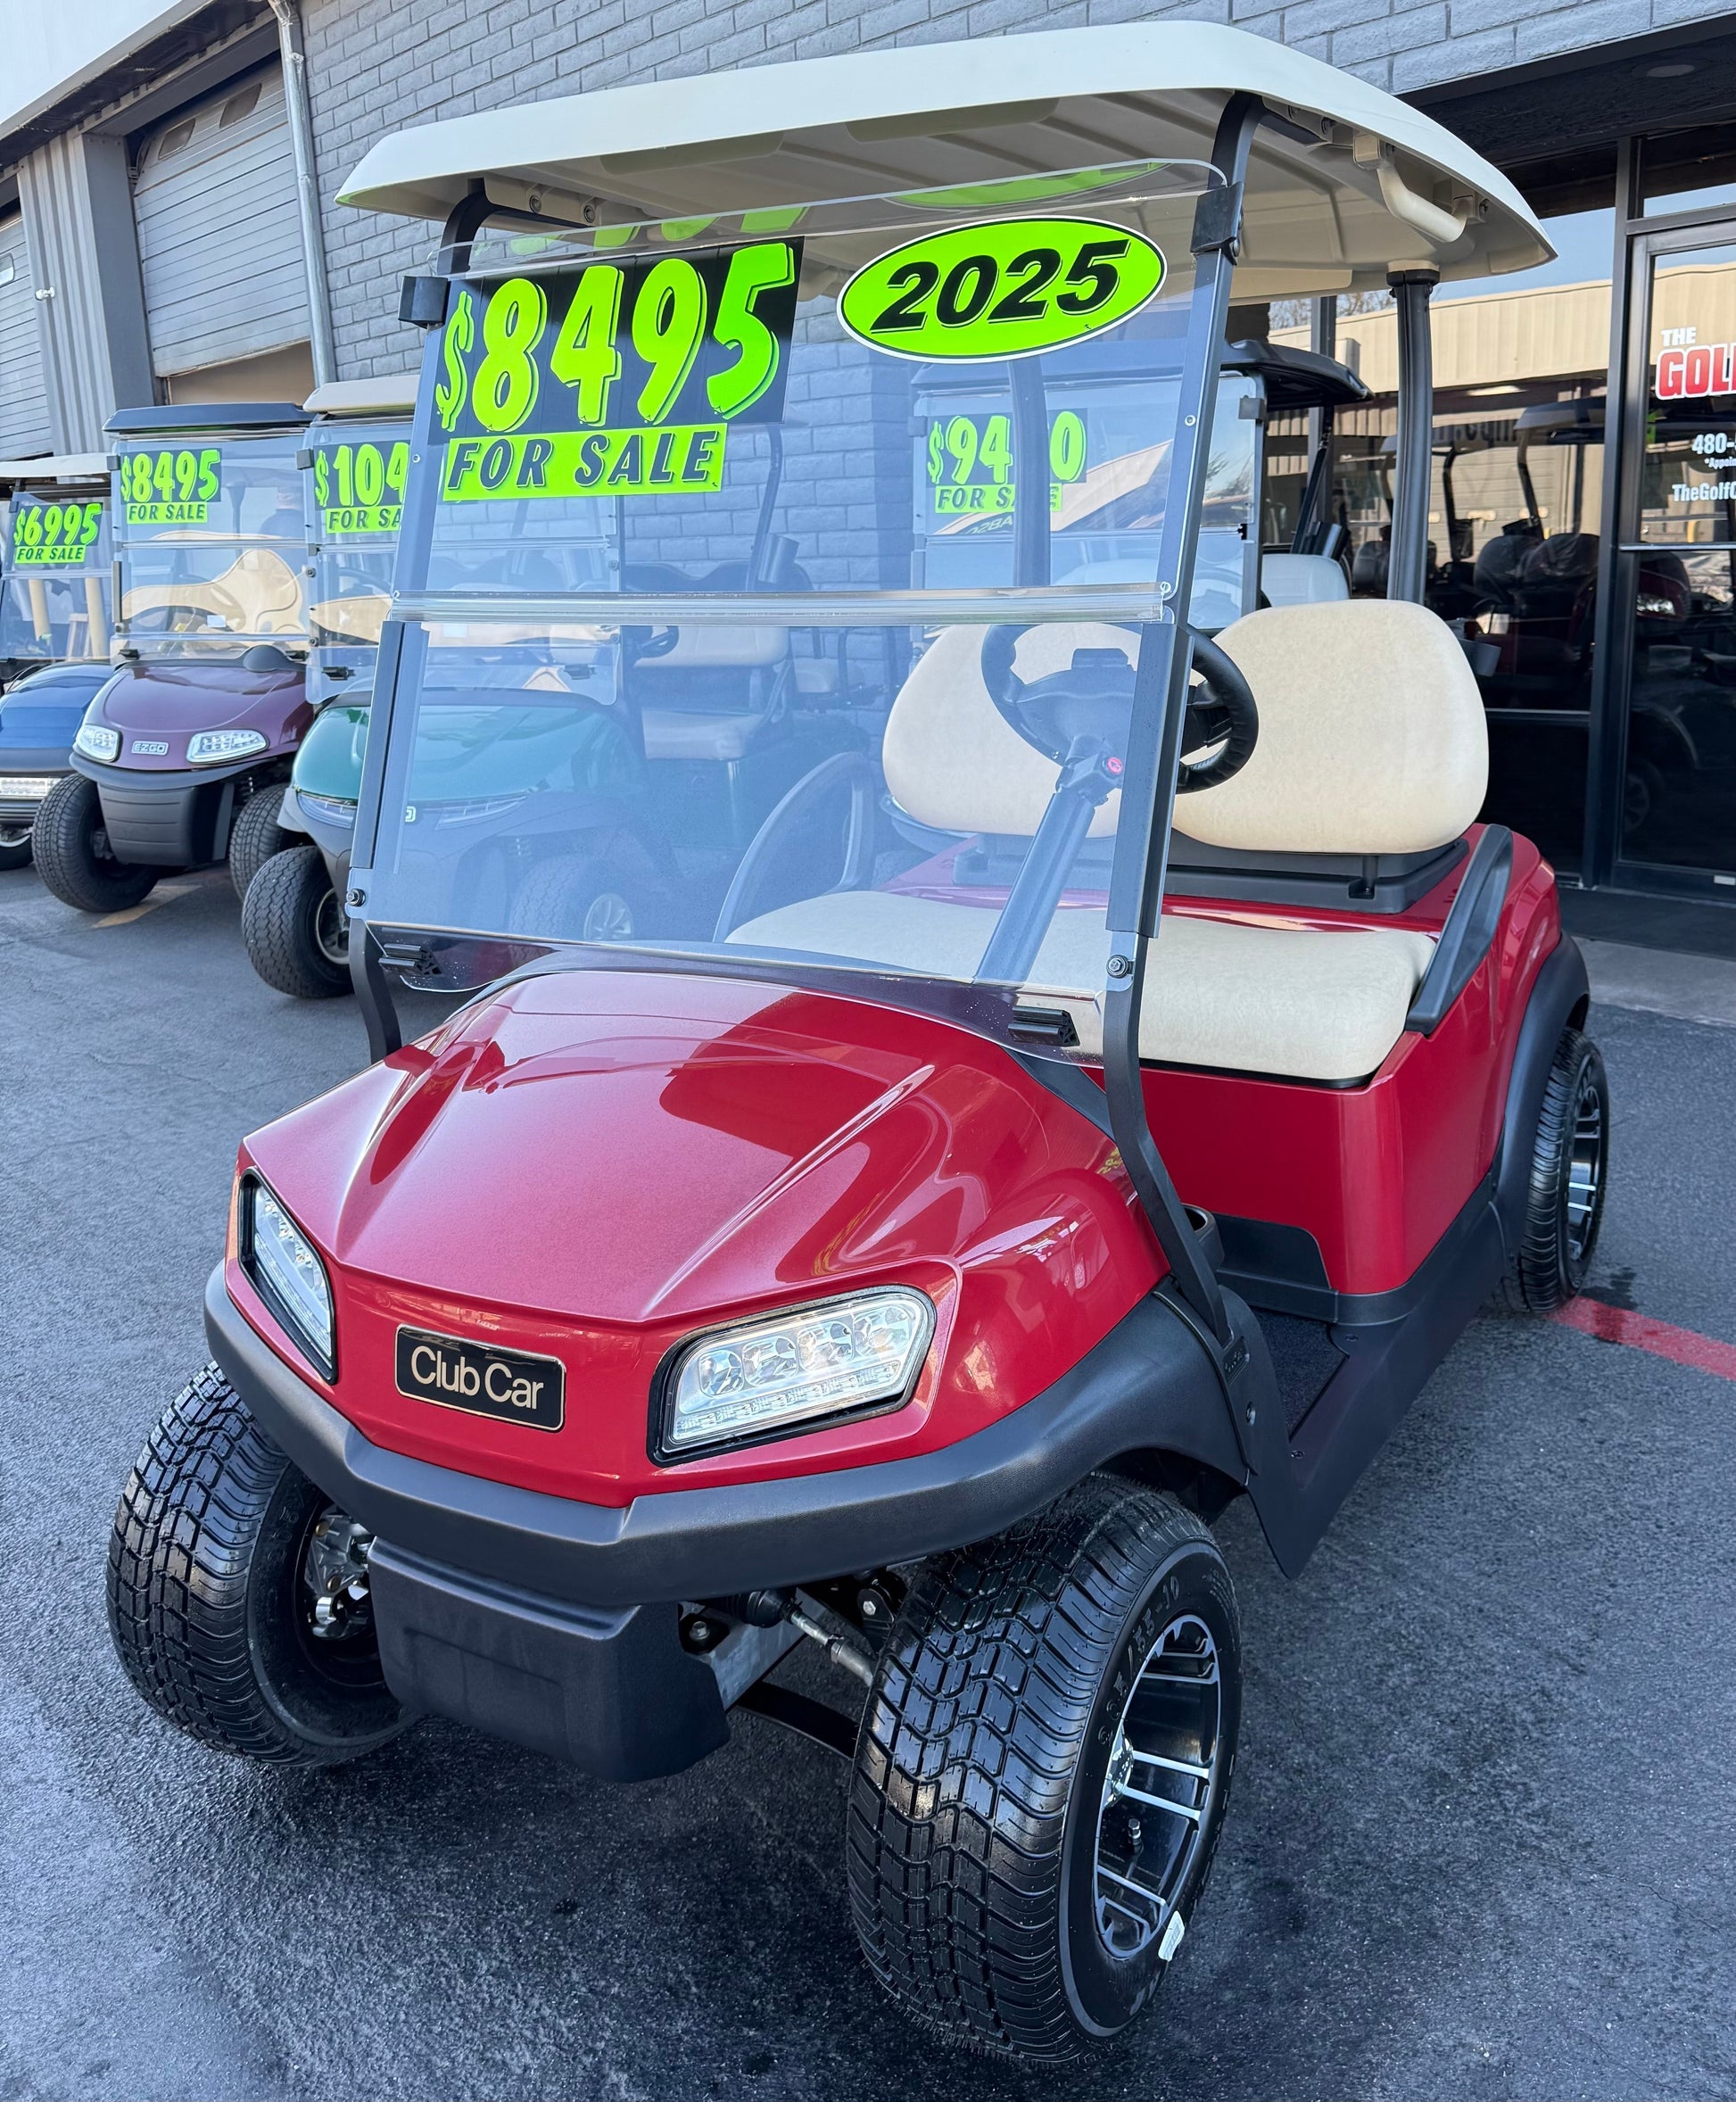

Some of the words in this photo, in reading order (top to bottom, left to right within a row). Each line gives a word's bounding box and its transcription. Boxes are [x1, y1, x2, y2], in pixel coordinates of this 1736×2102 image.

[870, 238, 1131, 334] 2025
[435, 242, 795, 432] $8495
[1660, 327, 1697, 346] THE
[1656, 342, 1736, 400] GOL
[447, 438, 553, 490] FOR
[574, 430, 720, 488] SALE
[928, 411, 1087, 484] $940
[1691, 433, 1736, 454] 480-
[120, 449, 220, 502] $8495
[938, 488, 986, 509] FOR
[996, 486, 1059, 509] SE
[13, 503, 102, 546] $6995
[128, 505, 158, 520] FOR
[166, 504, 205, 520] SALE
[328, 510, 368, 530] FOR
[17, 548, 44, 560] FOR
[49, 547, 83, 560] SALE
[411, 1345, 480, 1396] Club
[484, 1362, 544, 1410] Car
